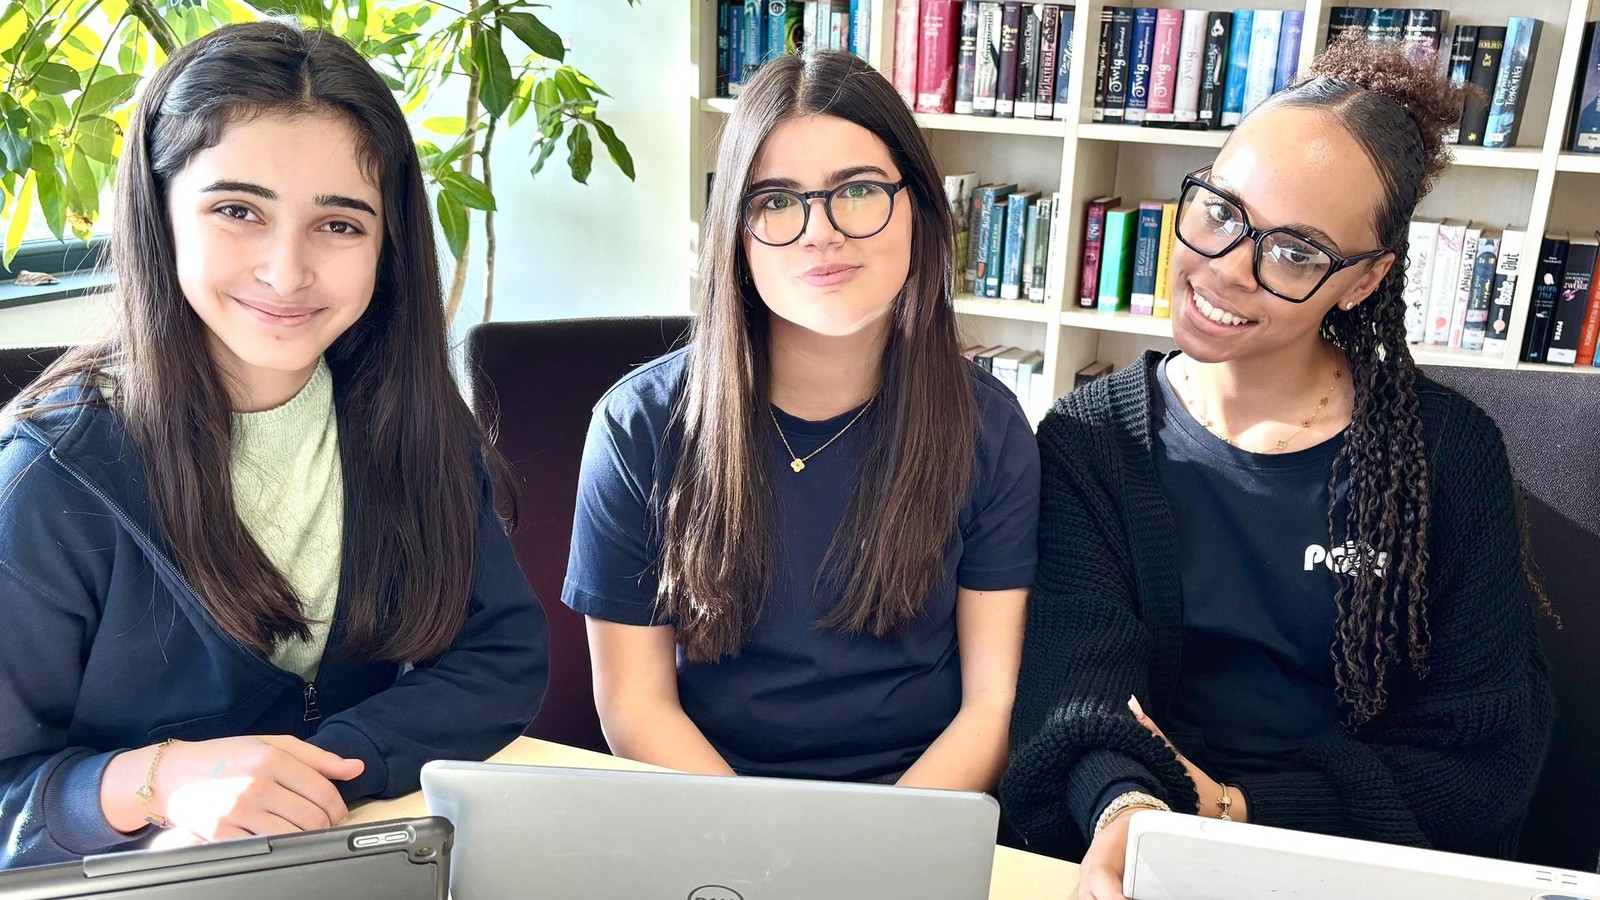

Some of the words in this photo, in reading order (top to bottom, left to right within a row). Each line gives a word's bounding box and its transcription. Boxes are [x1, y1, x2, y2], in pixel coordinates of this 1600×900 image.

[1024, 14, 1034, 36] Diaries
[1021, 36, 1032, 65] Vampire
[1108, 58, 1126, 93] Twig
[1131, 63, 1150, 98] Twig
[1153, 63, 1172, 98] Twig
[1181, 50, 1199, 88] Twig
[1553, 320, 1564, 341] PIPER
